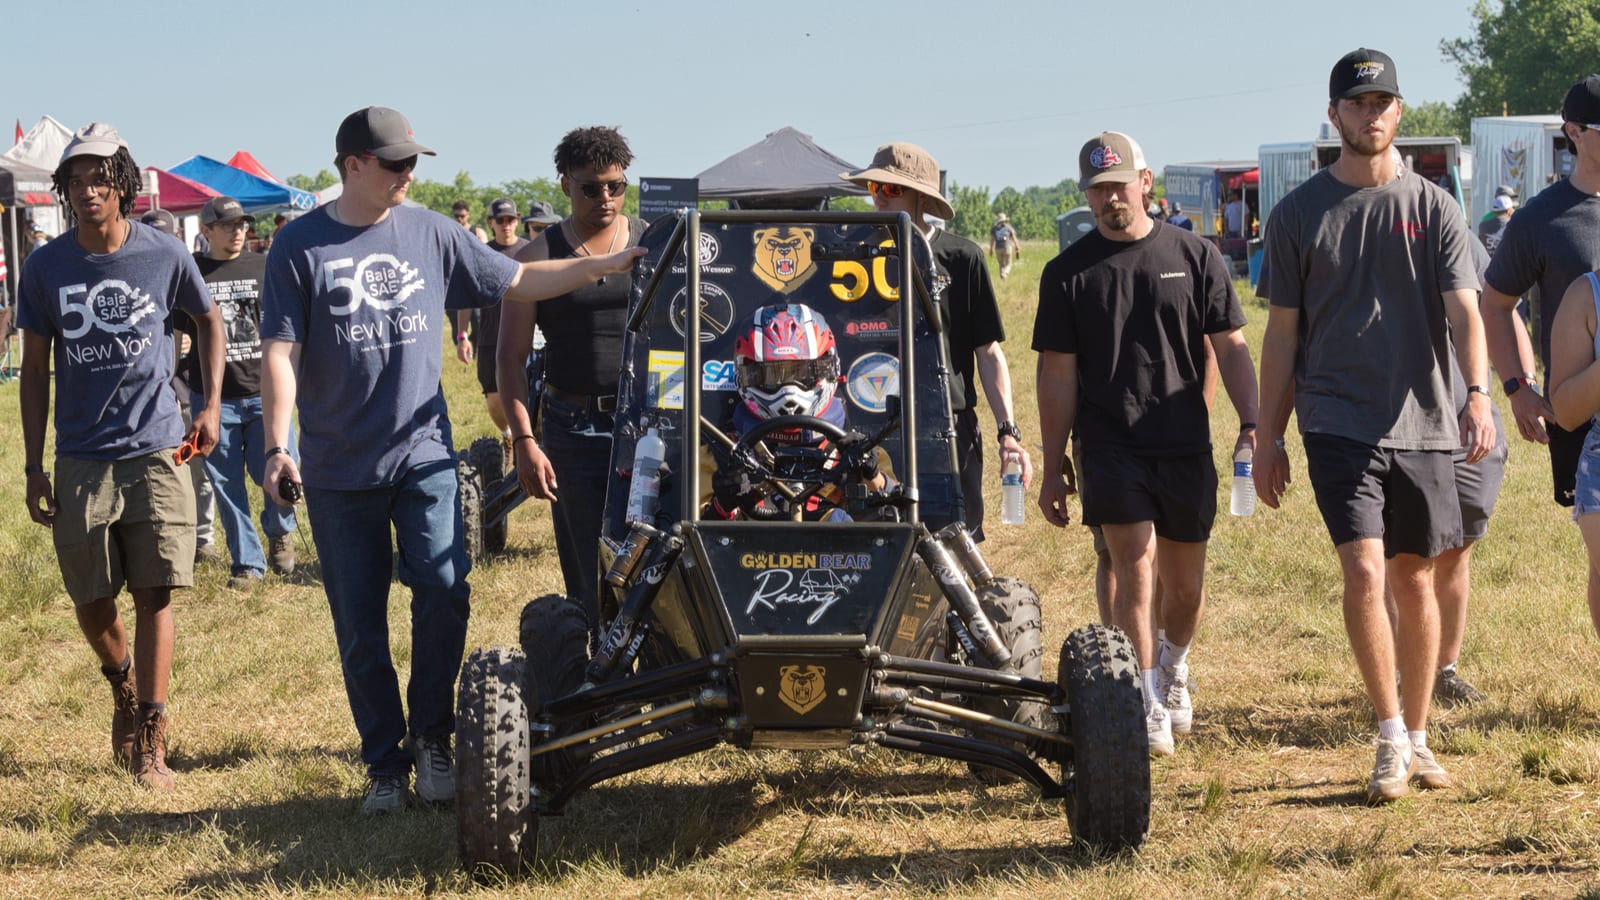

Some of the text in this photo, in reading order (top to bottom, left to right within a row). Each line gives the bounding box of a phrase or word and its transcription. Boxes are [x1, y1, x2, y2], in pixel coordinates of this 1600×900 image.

[365, 267, 396, 283] Baja
[97, 292, 127, 308] Baja
[334, 320, 383, 345] New
[385, 309, 428, 334] York
[859, 321, 888, 331] OMG
[66, 343, 113, 367] New
[703, 361, 736, 384] SA
[819, 554, 872, 570] BEAR
[745, 568, 841, 625] Racing
